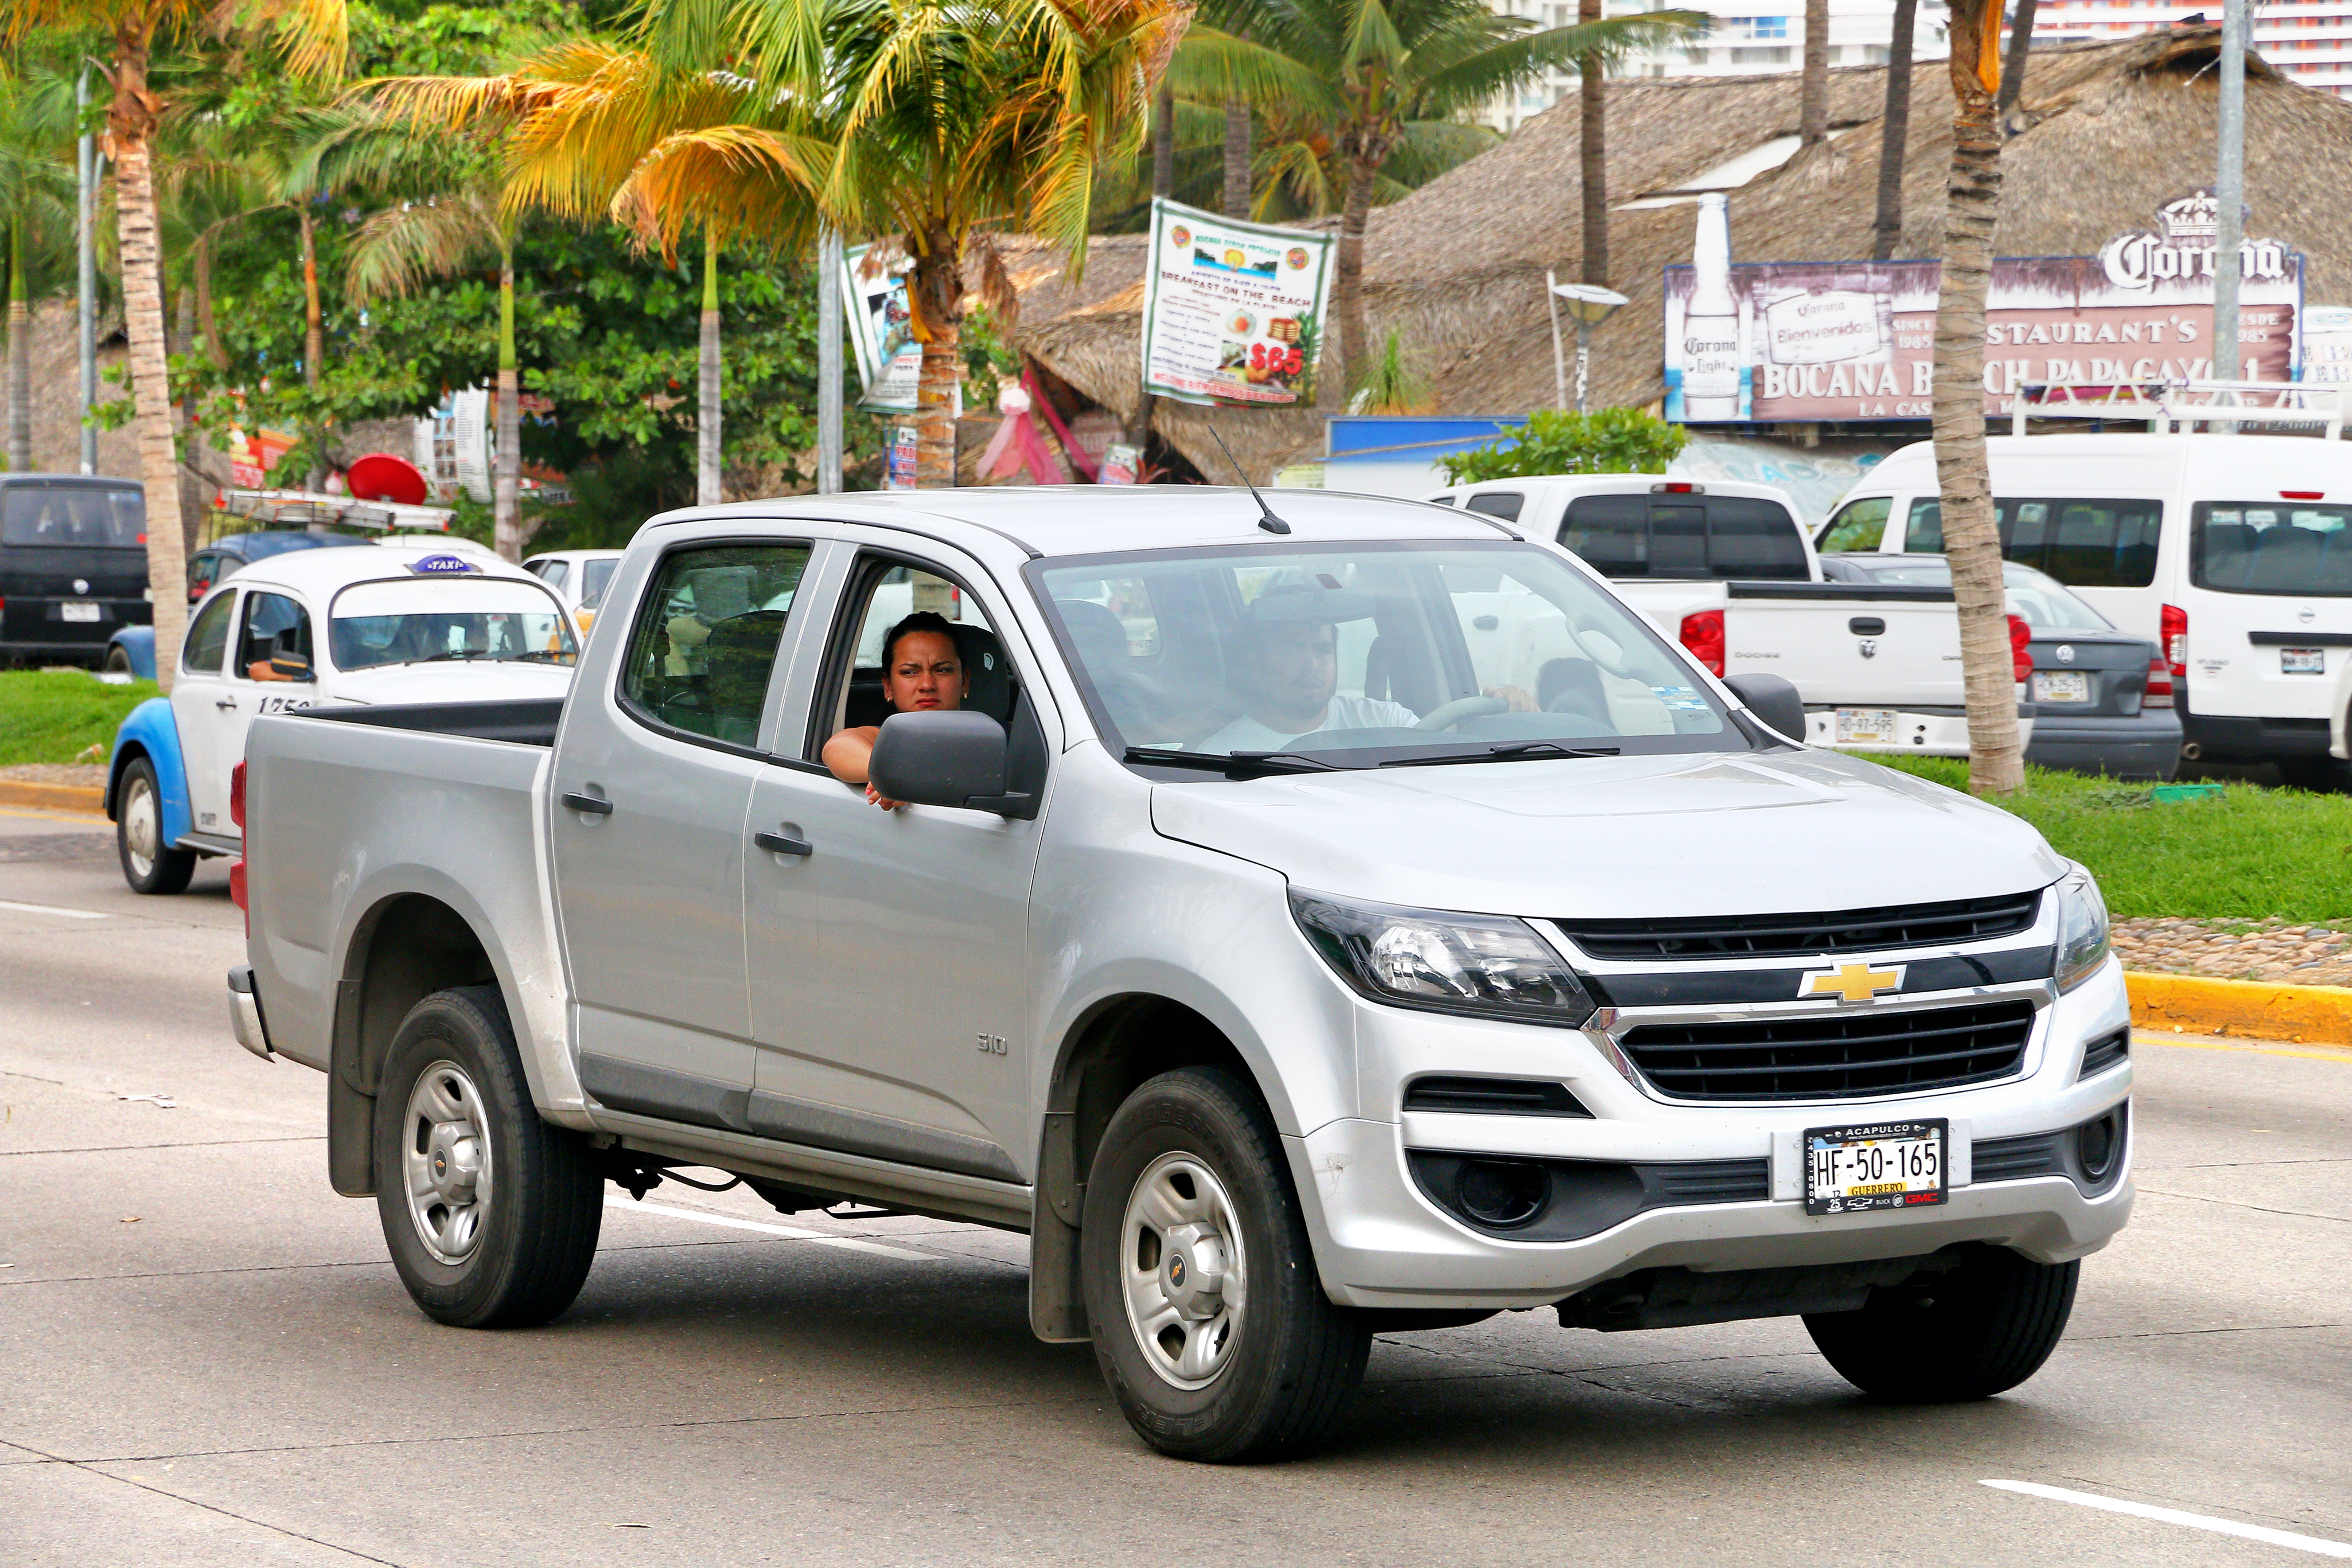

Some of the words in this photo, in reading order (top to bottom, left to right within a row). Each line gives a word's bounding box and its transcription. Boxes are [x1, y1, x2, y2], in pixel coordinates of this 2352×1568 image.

[1161, 271, 1219, 292] BREAKFAST
[1223, 286, 1239, 296] ON
[1243, 290, 1264, 301] THE
[1272, 295, 1311, 307] BEACH
[1798, 302, 1844, 317] Corona
[1892, 319, 1933, 332] SINCE
[2238, 313, 2280, 326] ESDE
[1778, 321, 1872, 343] Bienvenidos
[1986, 315, 2198, 345] STAURANT'S
[2238, 329, 2269, 343] 985
[1684, 337, 1736, 356] Corona
[1898, 334, 1933, 349] 1985
[1249, 342, 1304, 375] $65
[1697, 358, 1726, 374] Light
[1762, 362, 1901, 400] BOCANA
[1910, 359, 2030, 396] BCH
[1859, 402, 1886, 418] LA
[1895, 400, 1933, 417] CAS
[1845, 1125, 1910, 1136] ACAPULCO
[1816, 1142, 1937, 1187] HF-50-165
[1852, 1183, 1903, 1196] GUERRERO
[1830, 1198, 1841, 1209] 25
[1906, 1193, 1938, 1203] GMC
